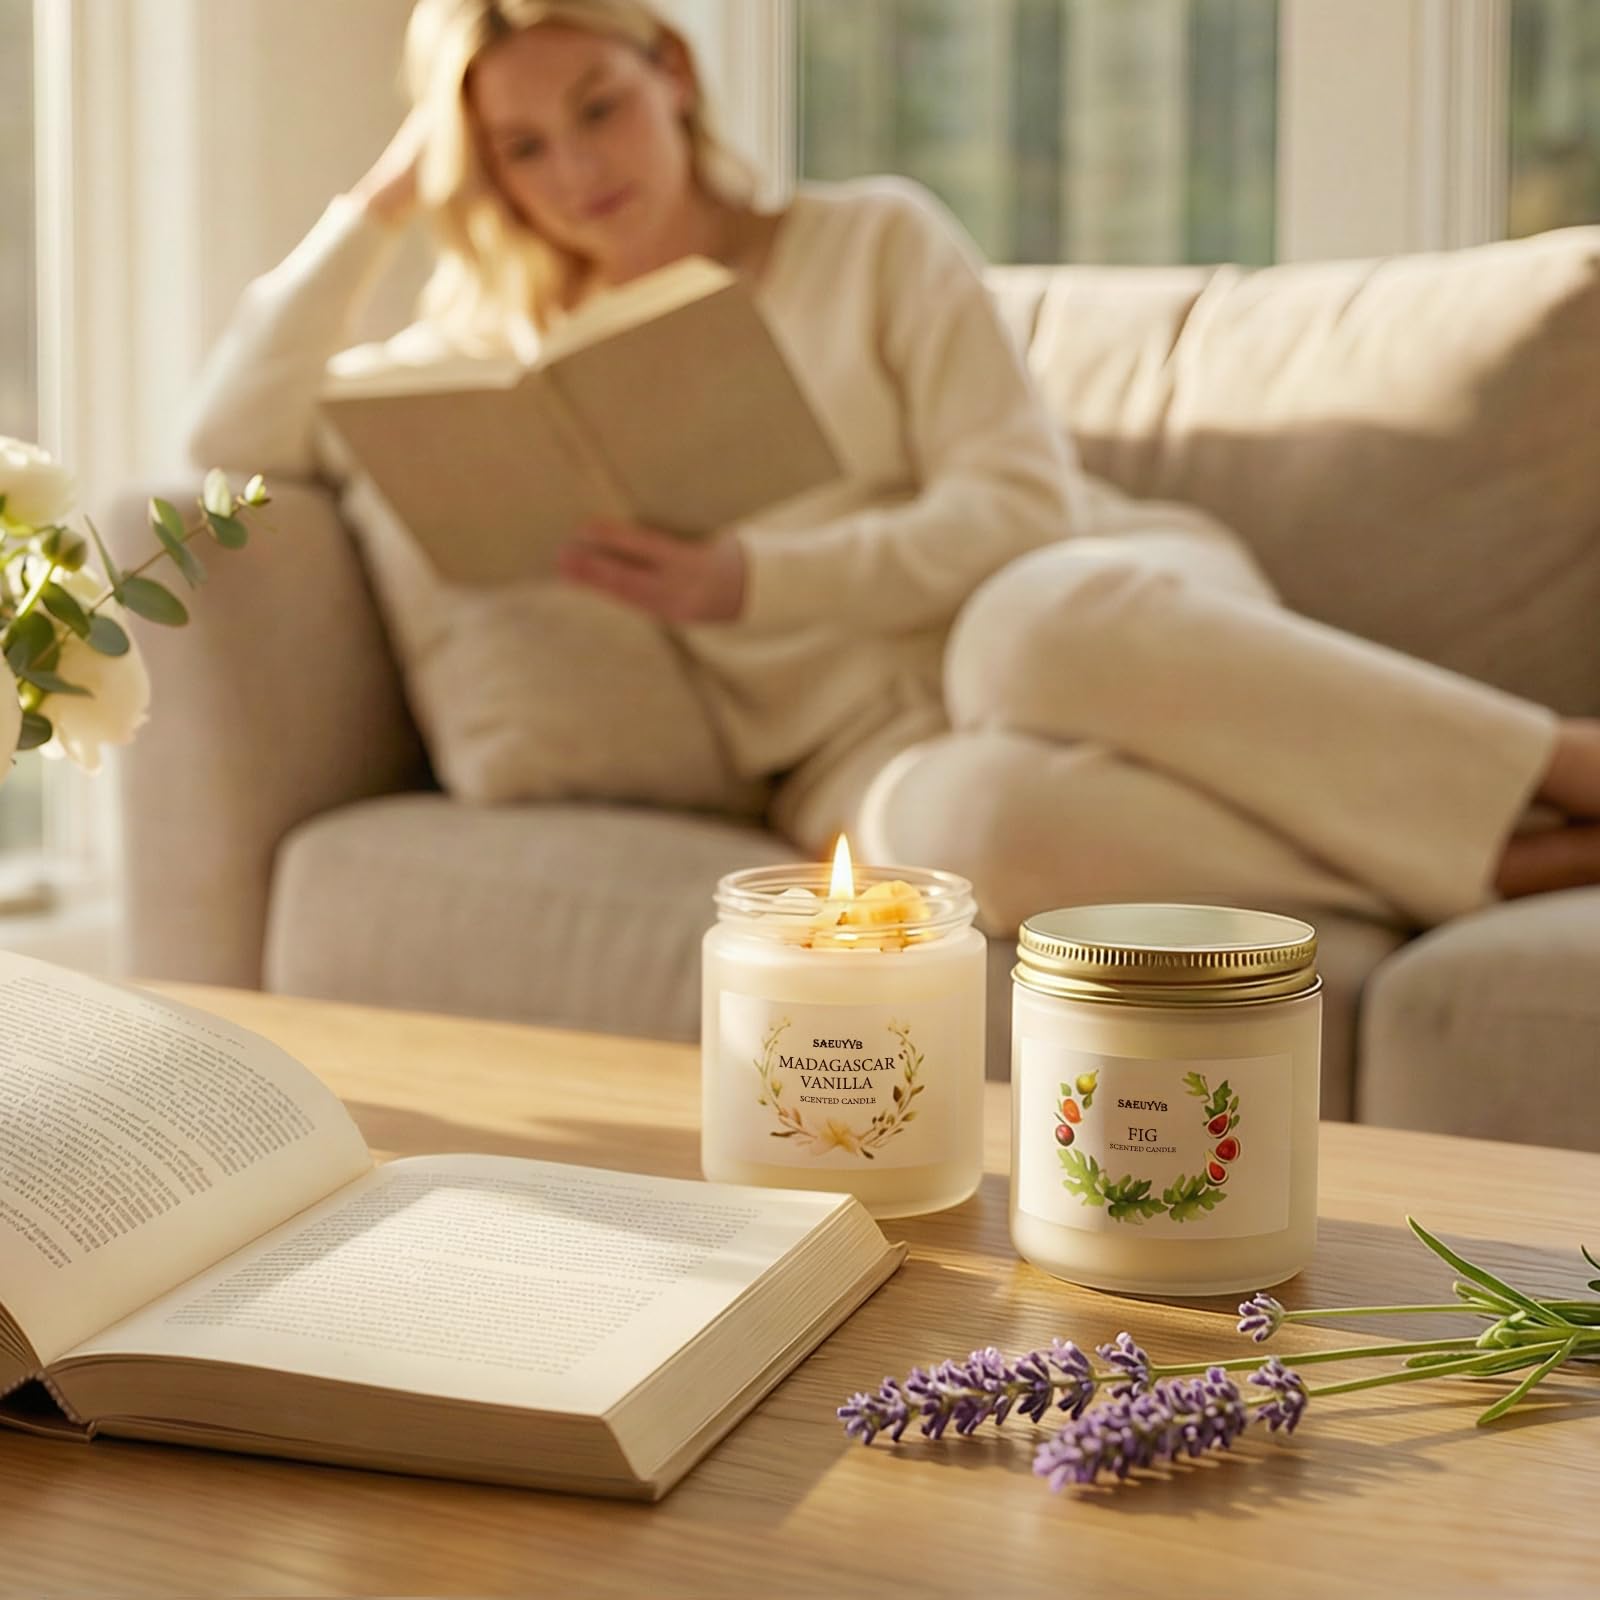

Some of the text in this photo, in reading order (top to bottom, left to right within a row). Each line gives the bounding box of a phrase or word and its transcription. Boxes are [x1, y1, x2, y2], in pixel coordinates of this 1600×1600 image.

[778, 1055, 896, 1072] MADAGASCAR
[800, 1075, 873, 1090] VANILLA
[799, 1095, 877, 1105] SCENTED CANDLE
[1117, 1098, 1168, 1112] SAEUYVB
[1127, 1127, 1157, 1142] FIG
[1109, 1143, 1145, 1153] SCENTED
